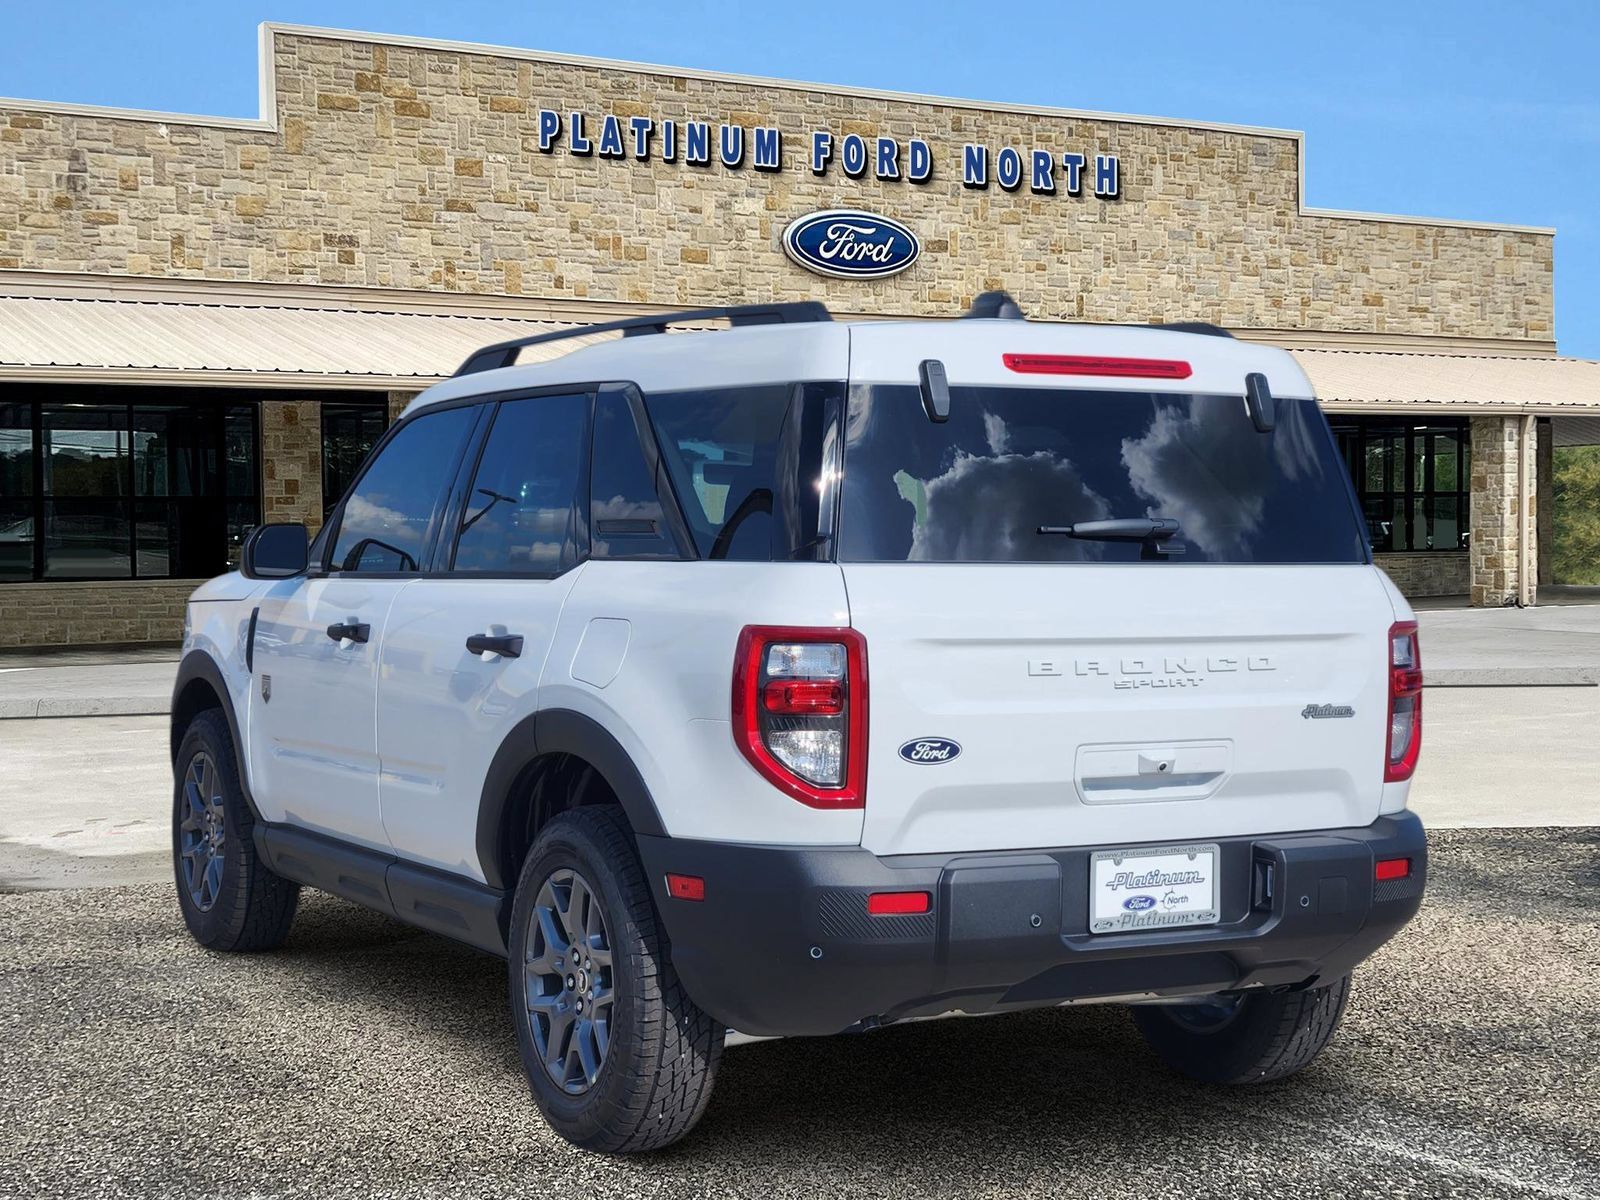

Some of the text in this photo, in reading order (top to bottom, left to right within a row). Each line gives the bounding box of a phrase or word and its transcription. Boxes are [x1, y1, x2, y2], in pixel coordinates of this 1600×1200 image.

[538, 109, 1121, 199] PLATINUM FORD NORTH
[817, 222, 894, 265] Ford
[1027, 655, 1277, 677] BRONCO
[1113, 678, 1204, 690] SPORT
[1301, 703, 1355, 719] Platinum
[911, 742, 950, 760] Ford
[1105, 869, 1205, 891] Platinum
[1167, 896, 1189, 905] North
[1119, 910, 1193, 929] Platinum
